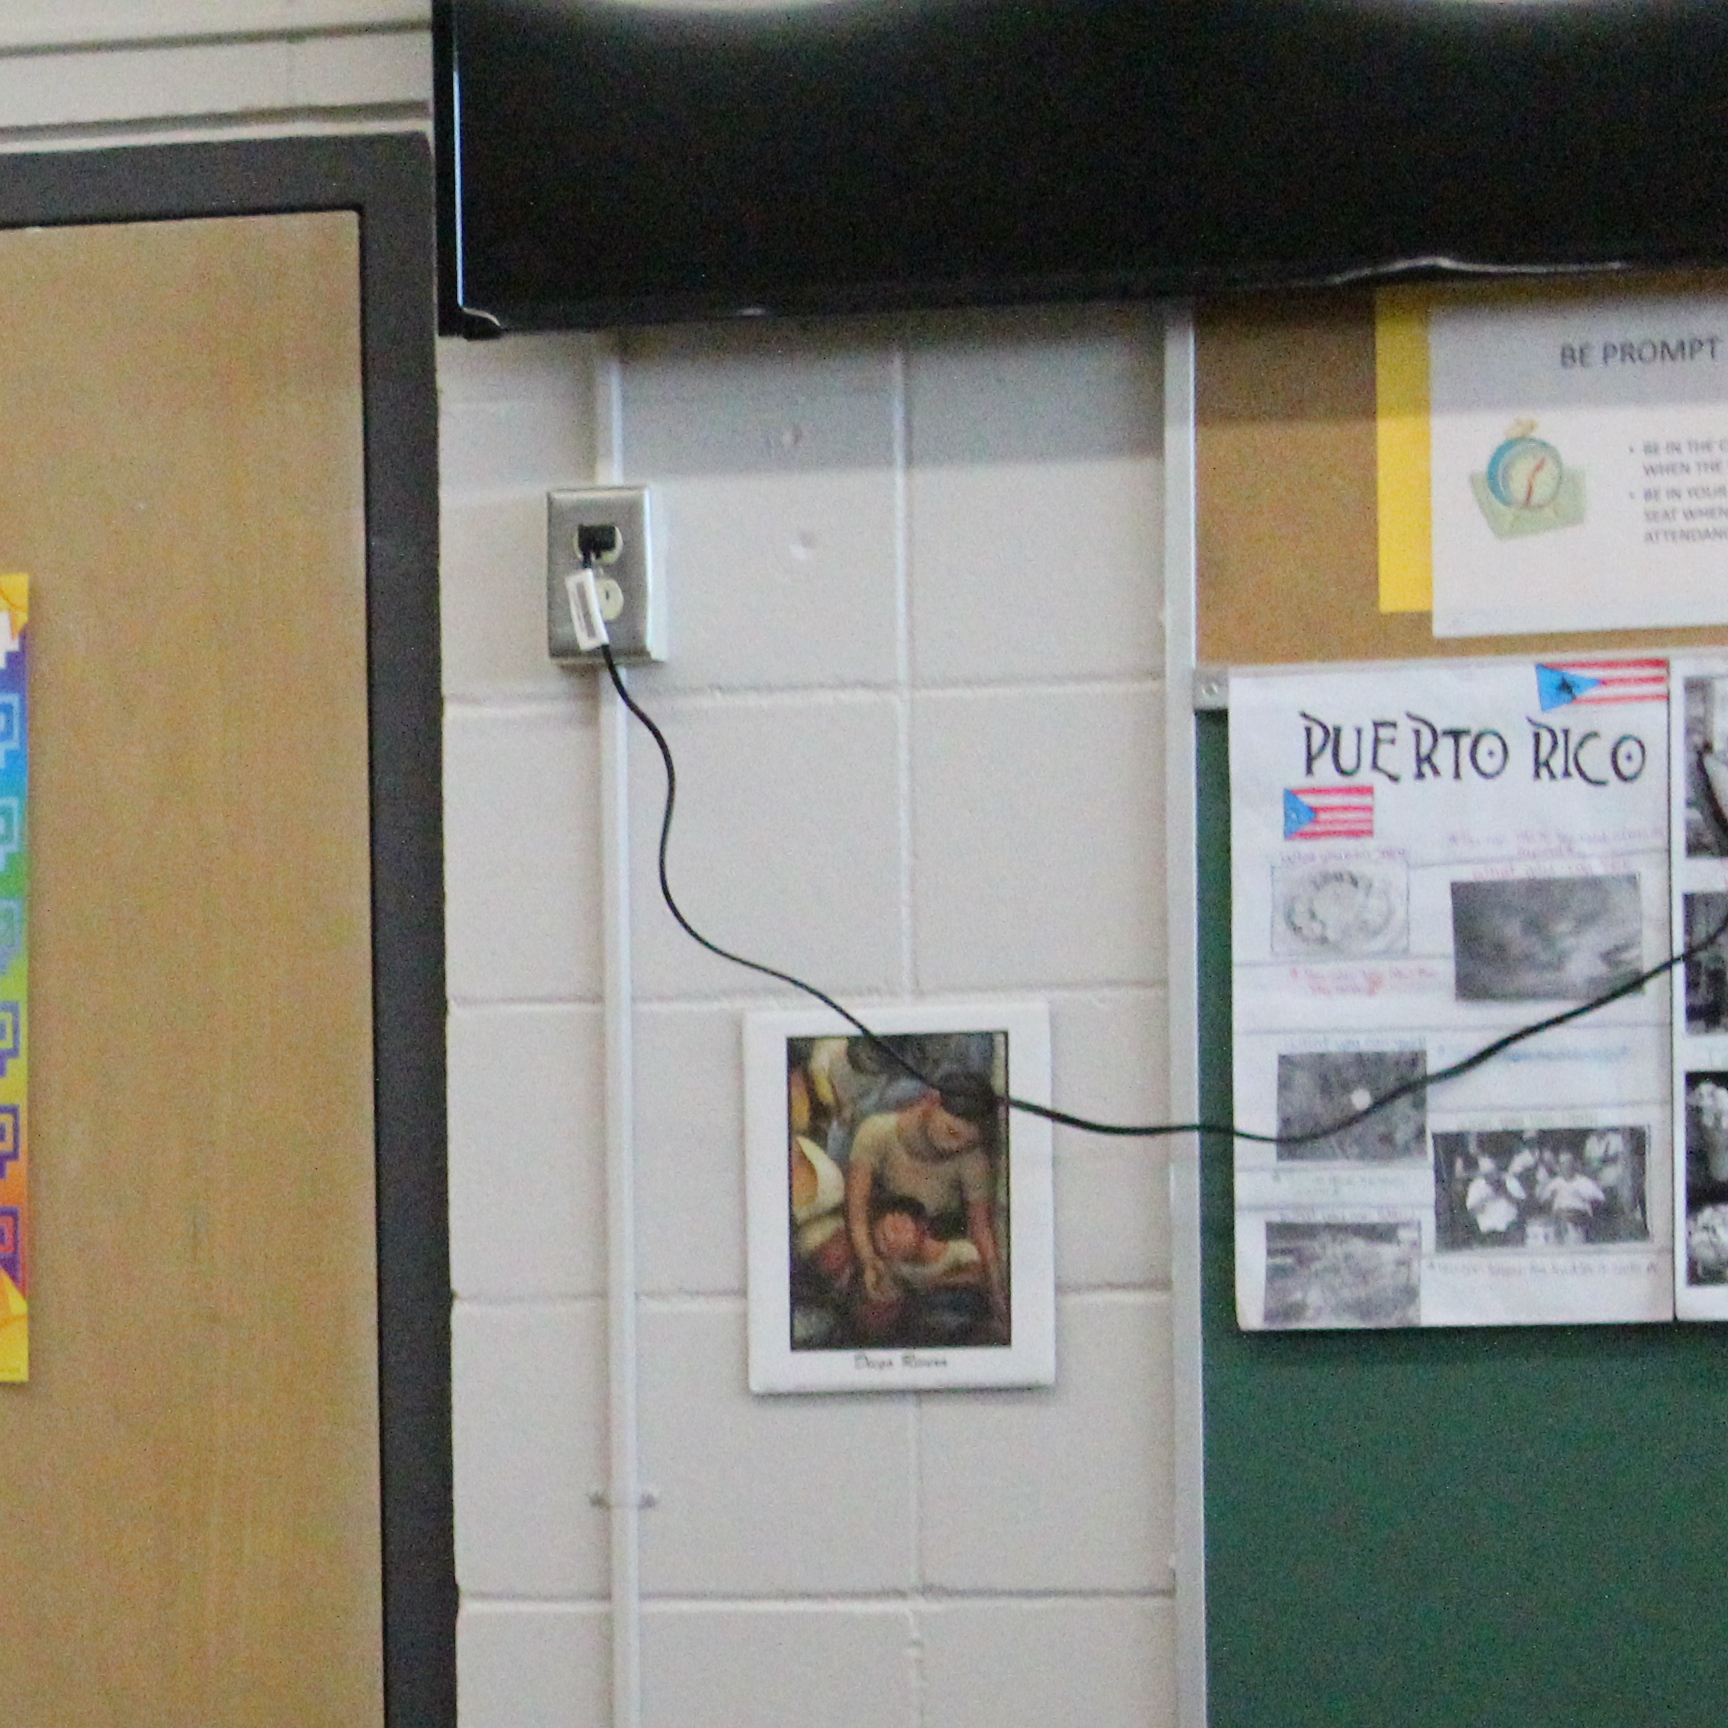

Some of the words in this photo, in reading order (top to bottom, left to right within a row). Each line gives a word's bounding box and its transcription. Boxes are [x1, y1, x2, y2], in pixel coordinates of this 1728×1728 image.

[1560, 342, 1592, 368] BE
[1603, 335, 1722, 366] PROMPT
[1300, 711, 1509, 784] PUERTO
[1528, 716, 1646, 786] RICO
